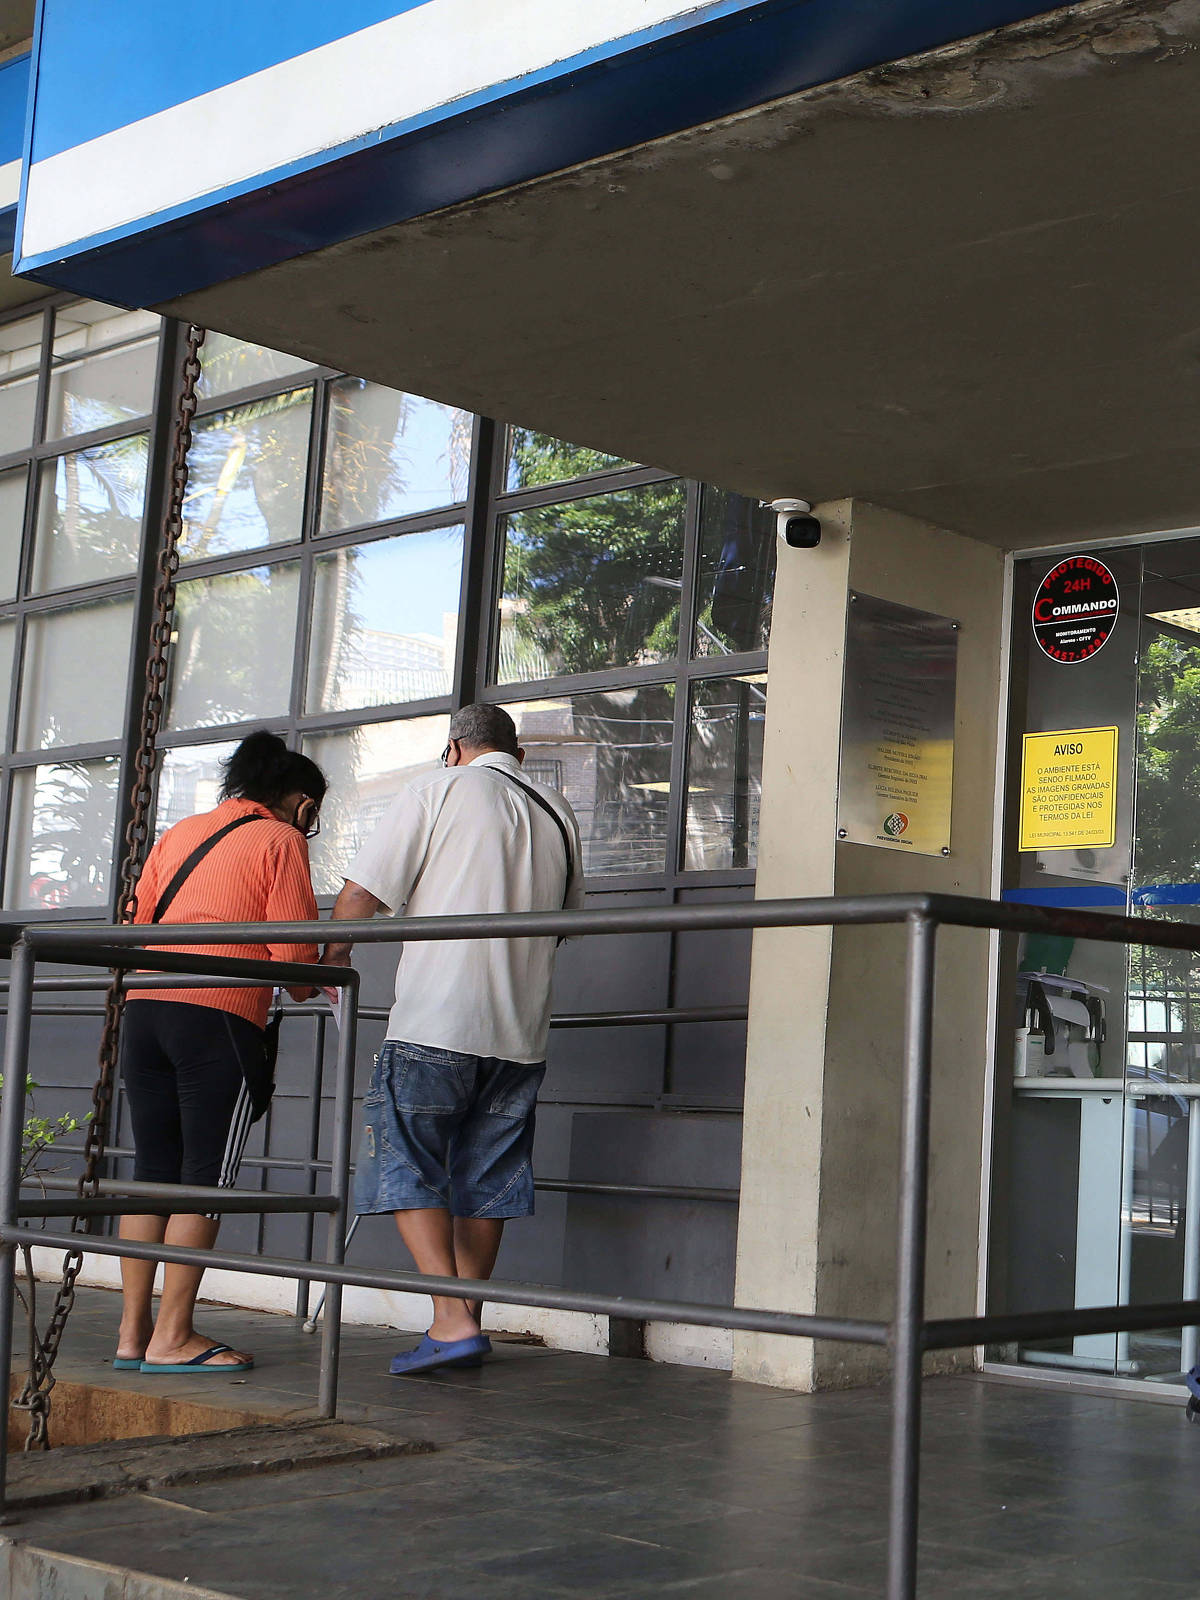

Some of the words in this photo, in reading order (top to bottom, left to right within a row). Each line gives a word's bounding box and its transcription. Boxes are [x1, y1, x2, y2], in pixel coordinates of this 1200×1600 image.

[1044, 558, 1112, 589] PROTEGIDO
[1064, 578, 1090, 594] 24H
[1035, 598, 1116, 622] COMMANDO
[1054, 743, 1083, 756] AVISO
[1044, 764, 1080, 774] AMBIENTE
[1082, 763, 1100, 771] ESTÁ
[1039, 776, 1064, 784] SENDO
[1065, 773, 1096, 782] FILMADO
[1038, 785, 1070, 794] IMAGENS
[1072, 782, 1110, 790] GRAVADAS
[1032, 795, 1046, 803] SÃO
[1048, 792, 1104, 802] CONFIDENCIAIS
[1040, 802, 1086, 812] PROTEGIDAS
[1040, 813, 1069, 821] TERMOS
